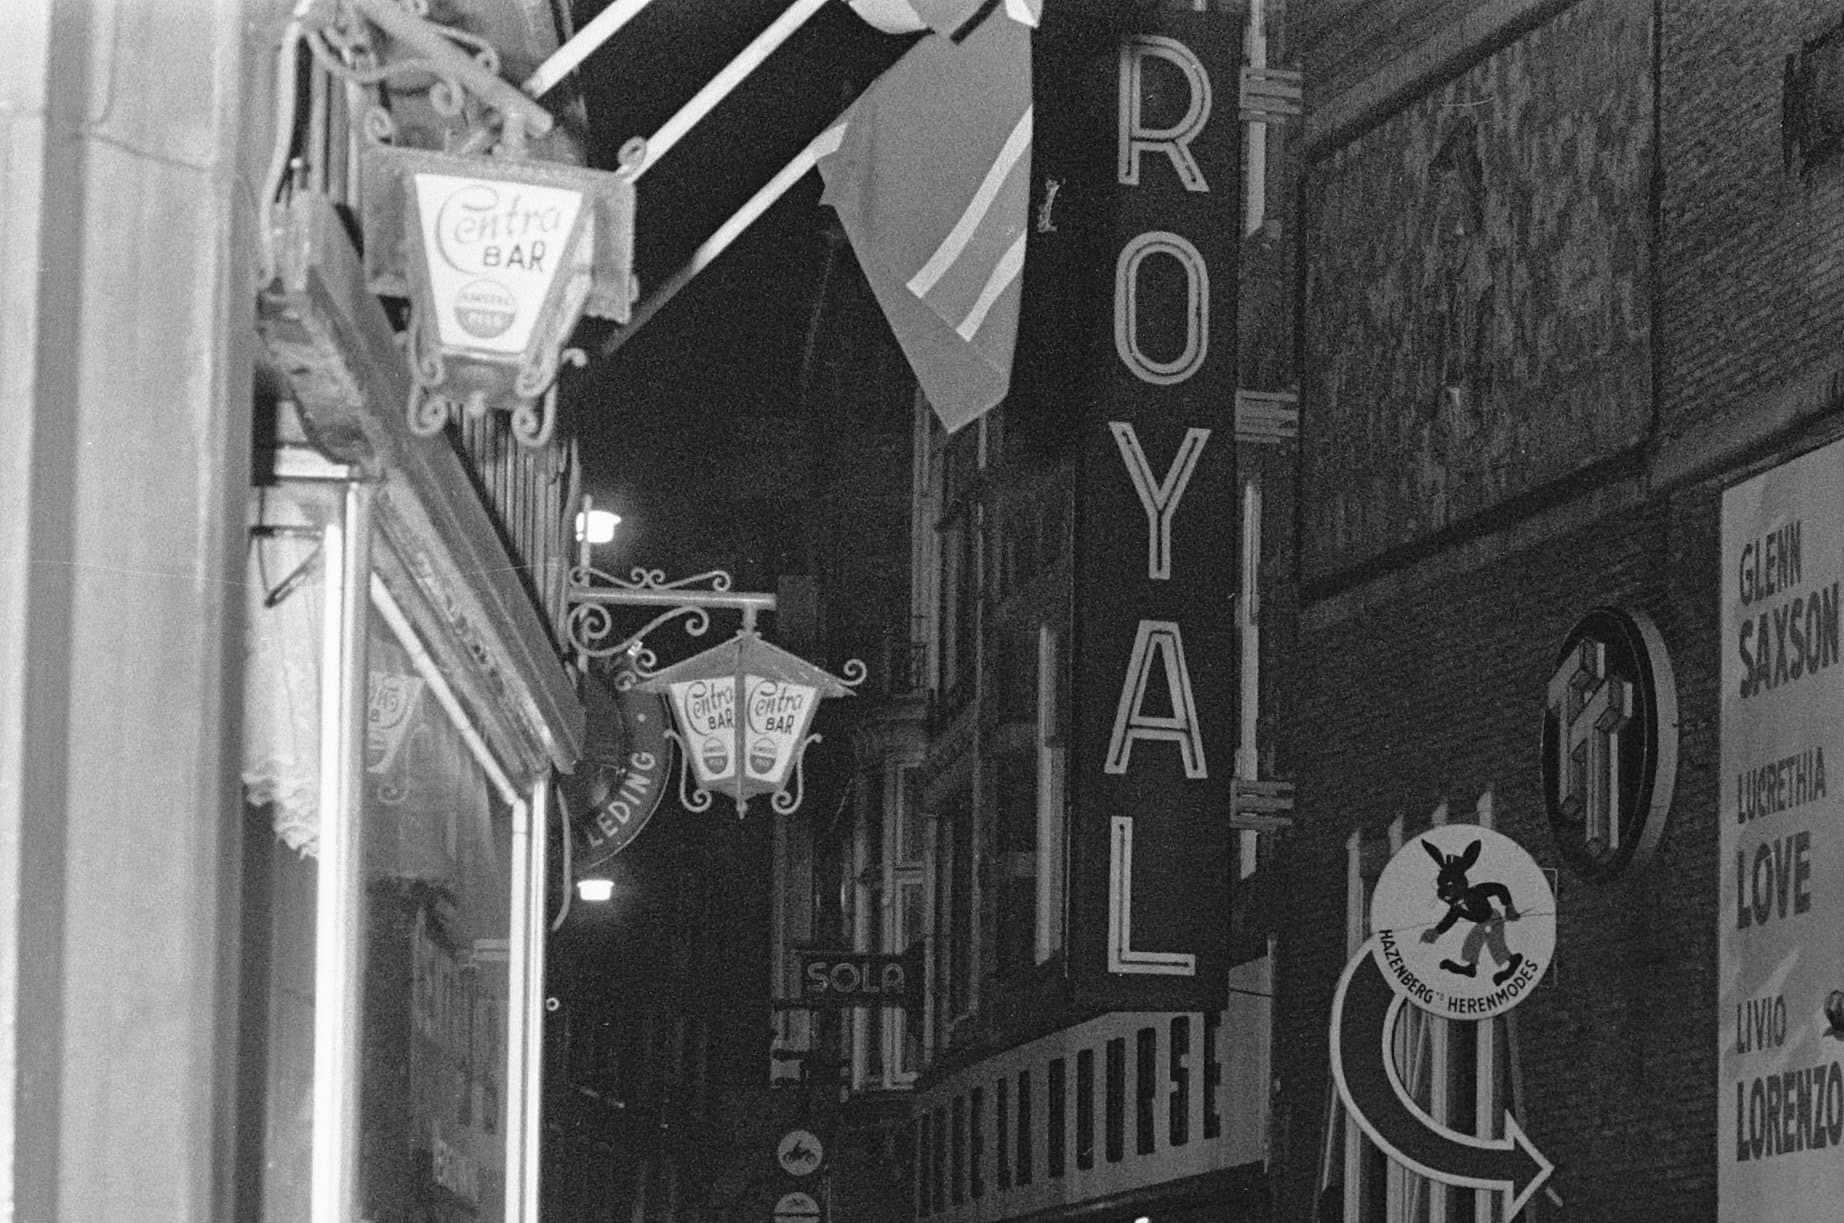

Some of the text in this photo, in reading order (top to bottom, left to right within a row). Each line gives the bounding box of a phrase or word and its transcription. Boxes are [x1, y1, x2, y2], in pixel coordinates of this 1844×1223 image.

[483, 239, 545, 272] BAR
[1104, 34, 1212, 976] ROYAL
[1739, 520, 1801, 606] GLENN
[1739, 581, 1839, 699] SAXSON
[708, 707, 735, 730] BAR
[765, 715, 794, 734] BAR
[1737, 746, 1827, 824] LUCRETHIA
[1737, 830, 1811, 930] LOVE
[1448, 959, 1538, 1013] HERENMODES
[1737, 994, 1786, 1054] LIVIO
